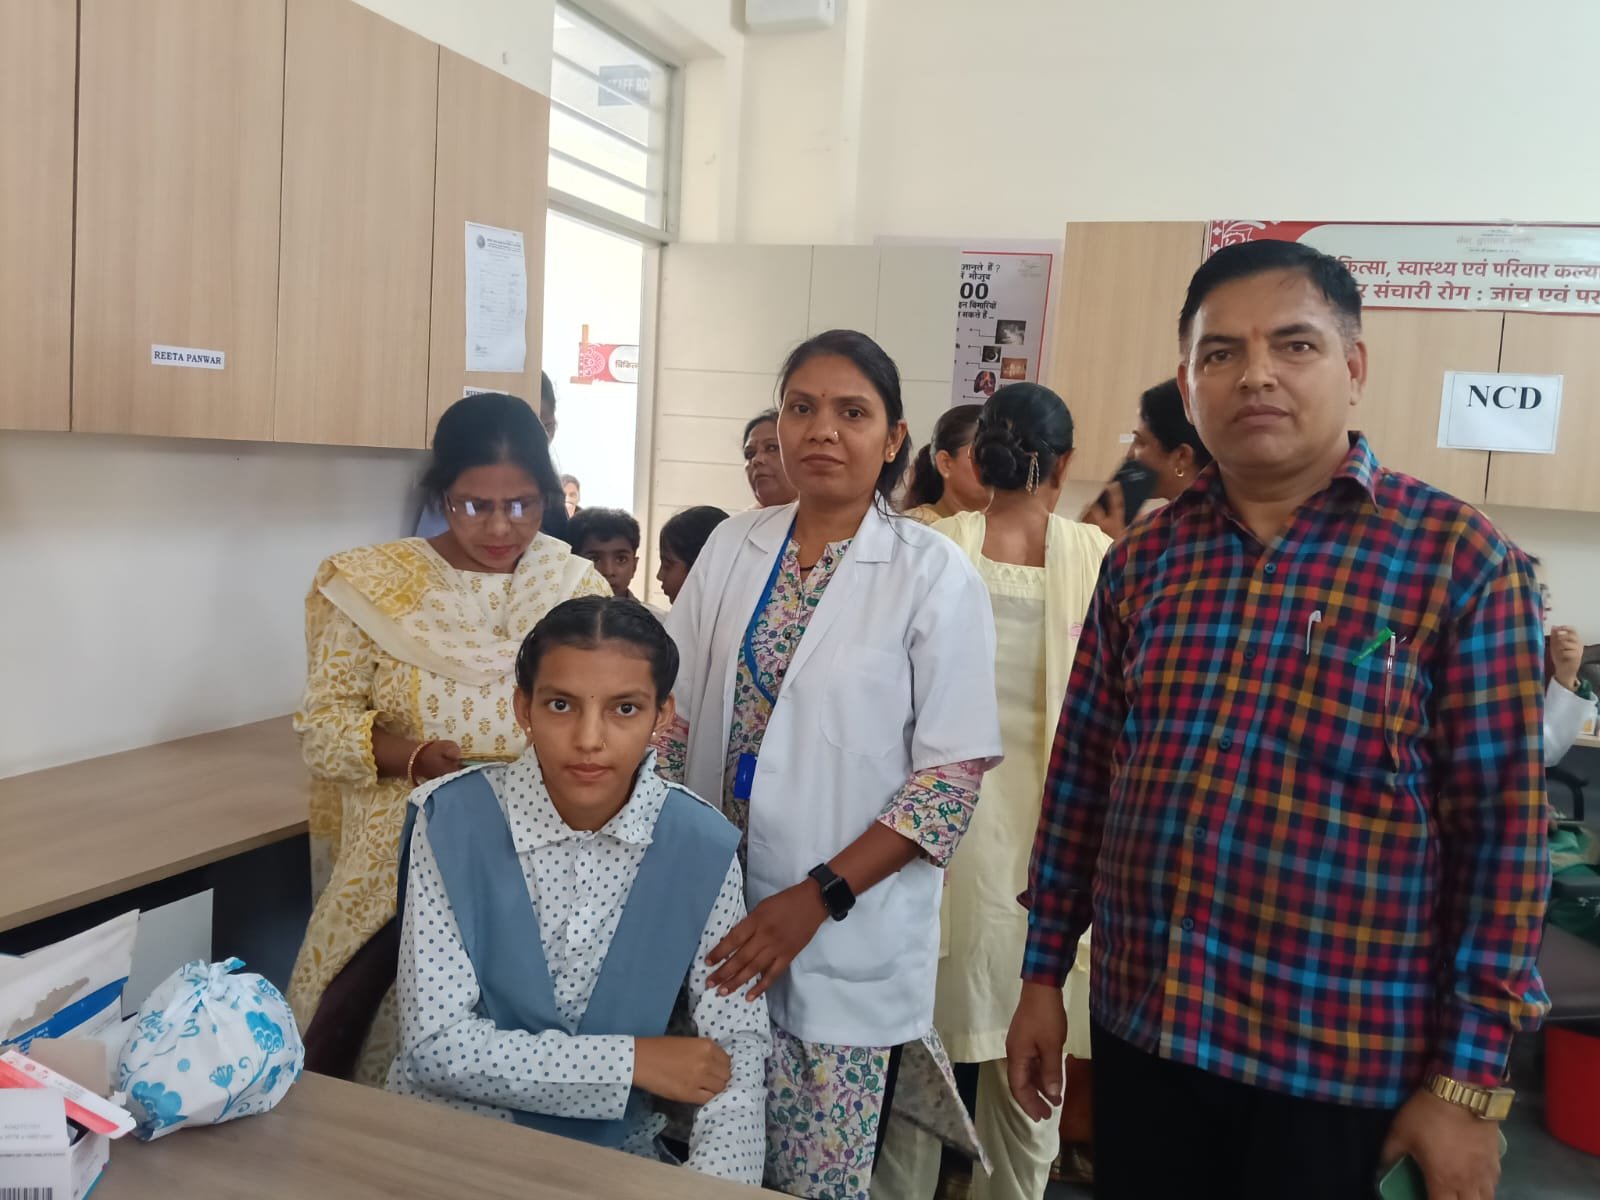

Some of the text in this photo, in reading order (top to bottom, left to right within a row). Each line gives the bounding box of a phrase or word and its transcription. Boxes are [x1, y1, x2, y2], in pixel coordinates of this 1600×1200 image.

[1338, 255, 1600, 279] कित्सा, स्वास्थ्य एवं परिवार कल्य
[1373, 280, 1432, 299] संचारी
[1437, 281, 1471, 300] रोग
[1490, 283, 1533, 302] जांच
[1538, 284, 1571, 303] एवं
[154, 350, 222, 365] REETA PANWAR
[1467, 384, 1542, 410] NCD
